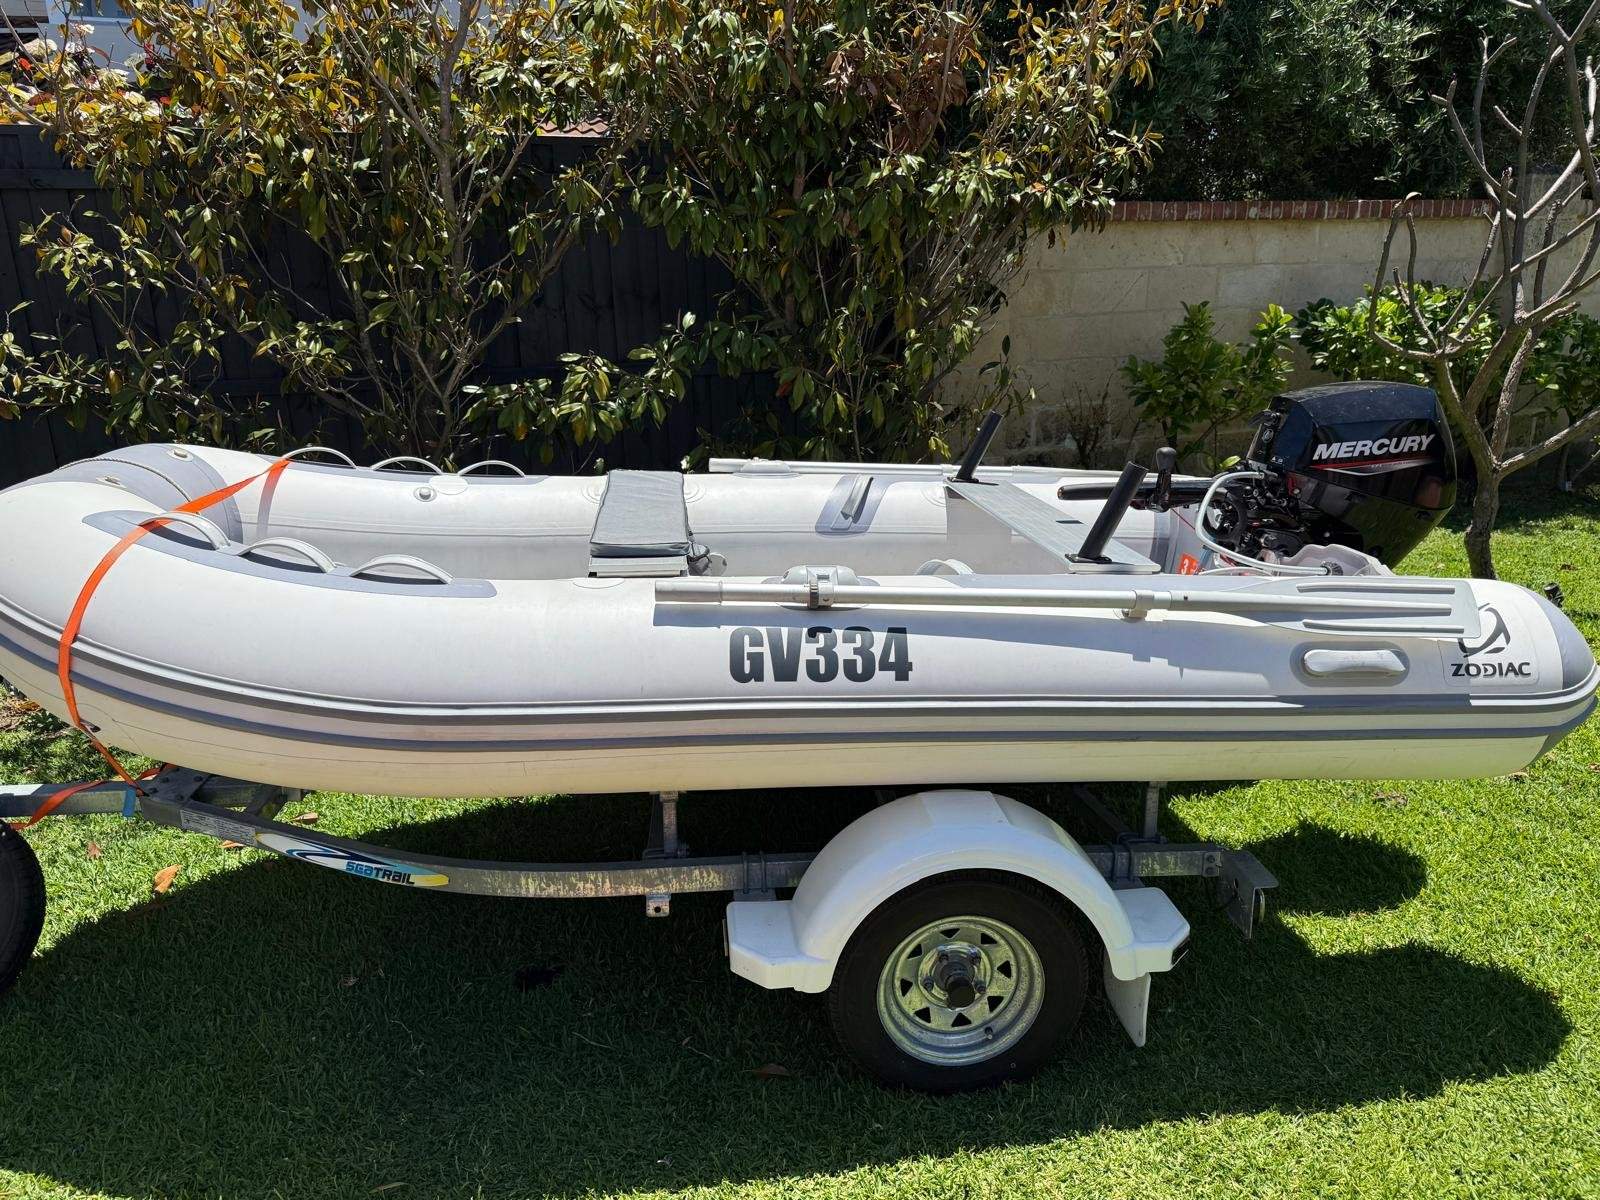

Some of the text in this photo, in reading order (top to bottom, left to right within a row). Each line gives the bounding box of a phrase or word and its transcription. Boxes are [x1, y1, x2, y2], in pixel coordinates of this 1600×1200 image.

[1312, 434, 1436, 460] MERCURY
[729, 625, 913, 683] GV334
[1450, 662, 1532, 678] ZODIAC
